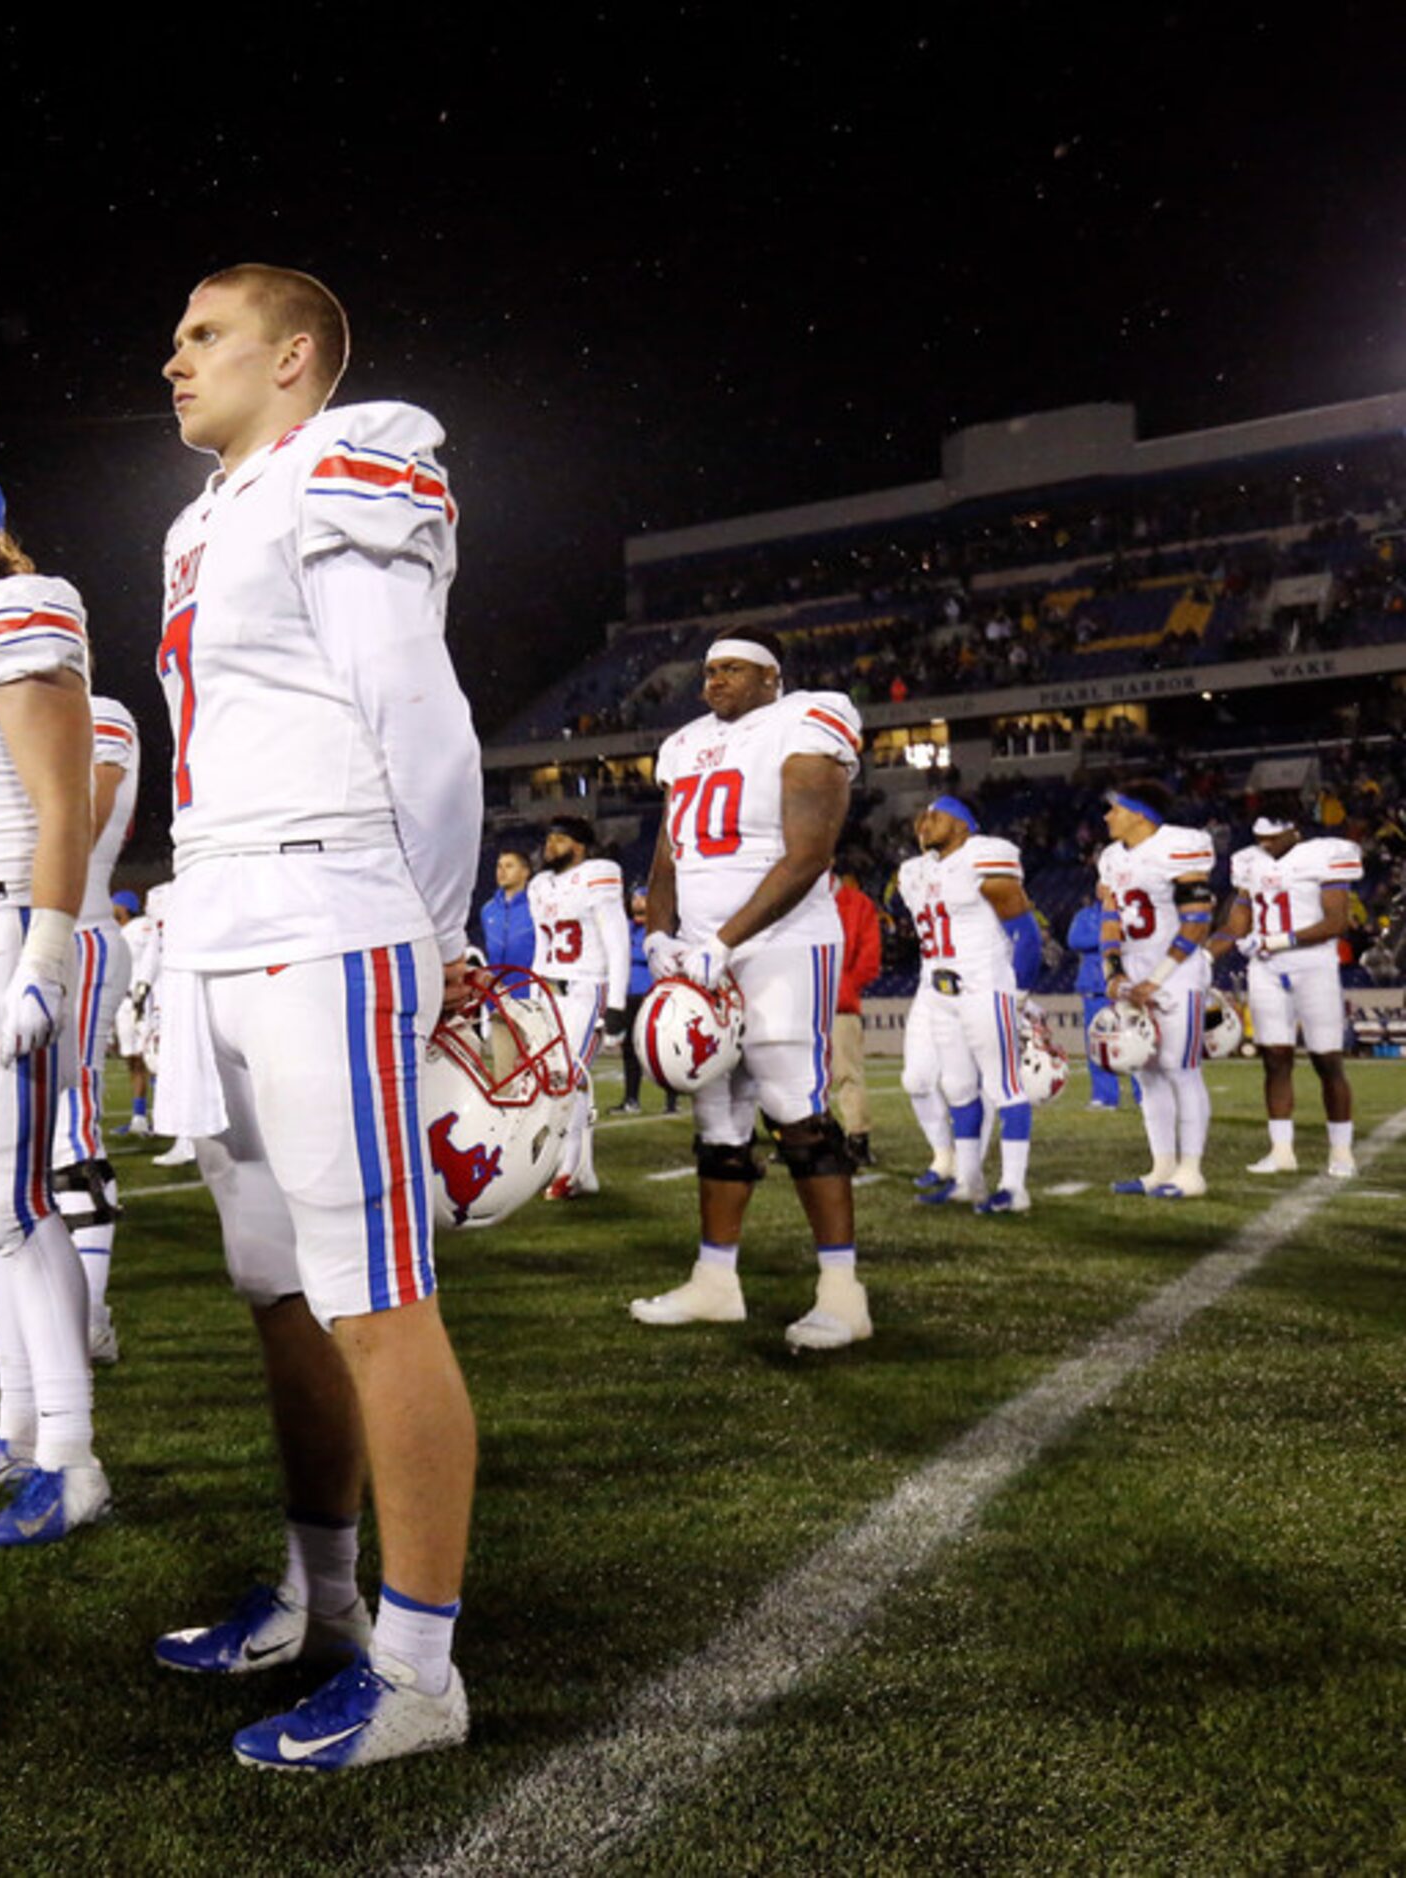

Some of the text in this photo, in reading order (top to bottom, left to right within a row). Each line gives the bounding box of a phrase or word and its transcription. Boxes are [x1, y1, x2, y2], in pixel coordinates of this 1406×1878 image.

[1040, 676, 1194, 705] PEARL HARBOR
[1270, 658, 1337, 679] WAKE
[157, 602, 198, 810] 7
[672, 767, 745, 859] 70
[1112, 887, 1157, 941] 3
[1254, 890, 1292, 936] 11
